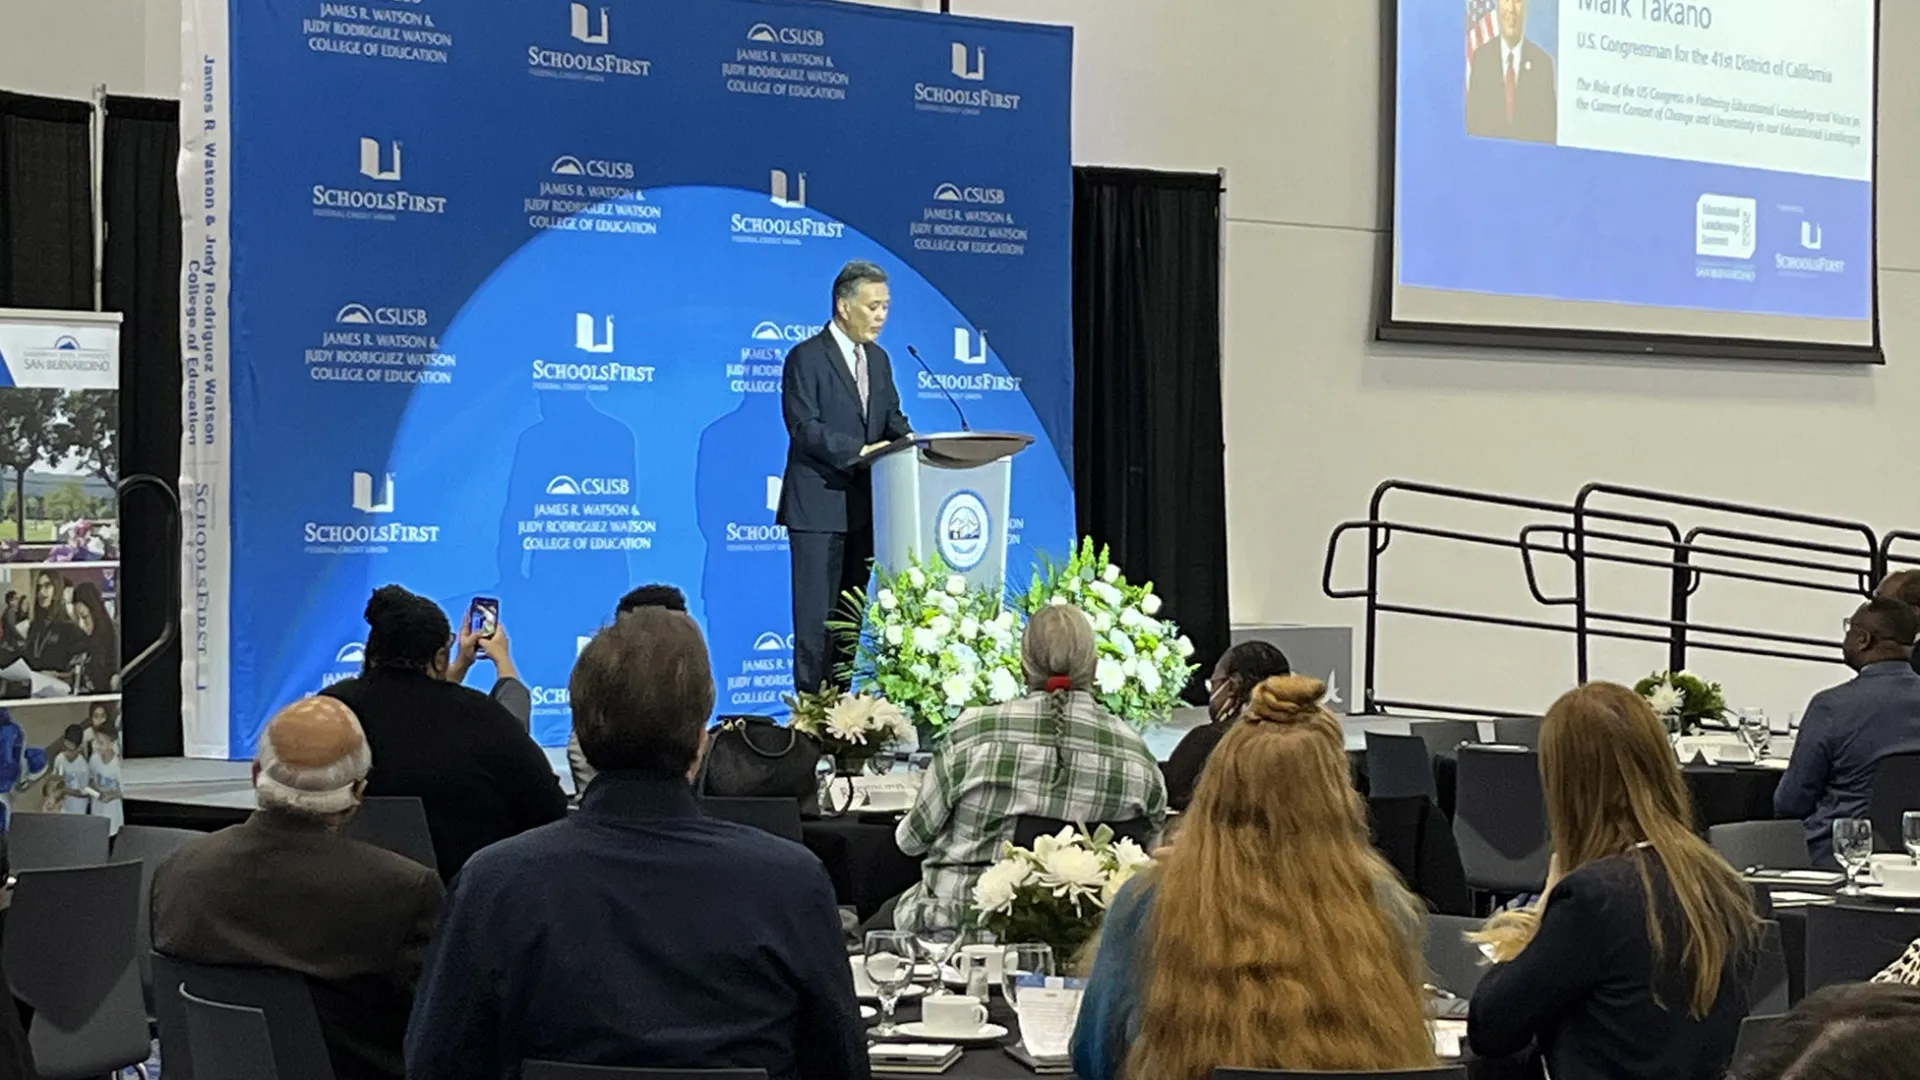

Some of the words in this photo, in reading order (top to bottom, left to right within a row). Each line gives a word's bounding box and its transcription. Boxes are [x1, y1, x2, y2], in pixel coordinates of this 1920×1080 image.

[320, 3, 358, 19] JAMES
[372, 8, 423, 26] WATSON
[424, 14, 435, 27] &
[303, 19, 330, 35] JUDY
[333, 22, 400, 40] RODRIGUEZ
[402, 31, 453, 46] WATSON
[780, 27, 824, 46] CSUSB
[308, 37, 361, 55] COLLEGE
[363, 42, 379, 56] OF
[380, 45, 448, 63] EDUCATION
[737, 48, 769, 62] JAMES
[780, 52, 824, 66] WATSON
[1600, 34, 1673, 60] Congressman
[1674, 43, 1689, 62] for
[1691, 47, 1709, 66] the
[1711, 51, 1733, 69] 41st
[1772, 60, 1785, 76] of
[721, 62, 746, 77] JUDY
[748, 65, 805, 81] RODRIGUEZ
[806, 71, 849, 85] WATSON
[204, 55, 215, 113] James
[727, 79, 771, 94] COLLEGE
[773, 83, 786, 95] OF
[788, 85, 845, 100] EDUCATION
[204, 143, 216, 209] Watson
[586, 159, 634, 179] CSUSB
[540, 182, 575, 196] JAMES
[587, 186, 634, 200] WATSON
[964, 187, 1005, 204] CSUSB
[524, 198, 549, 213] JUDY
[552, 200, 614, 215] RODRIGUEZ
[615, 203, 661, 218] WATSON
[205, 215, 216, 227] &
[529, 215, 577, 230] COLLEGE
[579, 218, 593, 231] OF
[595, 219, 657, 234] EDUCATION
[202, 236, 216, 276] Judy
[186, 260, 199, 329] College
[375, 308, 427, 326] CSUSB
[201, 282, 216, 373] Rodriguez
[784, 324, 824, 341] CSUS
[187, 333, 199, 351] of
[323, 332, 361, 347] JAMES
[376, 335, 427, 348] WATSON
[24, 359, 44, 370] SAN
[305, 349, 334, 364] JUDY
[336, 350, 404, 365] RODRIGUEZ
[406, 353, 457, 367] WATSON
[311, 367, 365, 381] COLLEGE
[366, 369, 382, 381] OF
[384, 370, 451, 384] EDUCATION
[731, 380, 776, 393] COLLEGE
[188, 357, 199, 445] Education
[204, 379, 216, 445] Watson
[581, 478, 630, 495] CSUSB
[534, 504, 569, 518] JAMES
[583, 504, 629, 516] WATSON
[518, 520, 543, 535] JUDY
[545, 520, 607, 533] RODRIGUEZ
[609, 520, 656, 532] WATSON
[726, 522, 790, 542] SCHOOL
[523, 537, 571, 550] COLLEGE
[573, 537, 587, 550] OF
[590, 537, 651, 550] EDUCATION
[742, 659, 775, 674] JAMES
[753, 674, 794, 687] RODRIG
[731, 691, 776, 704] COLLEGE
